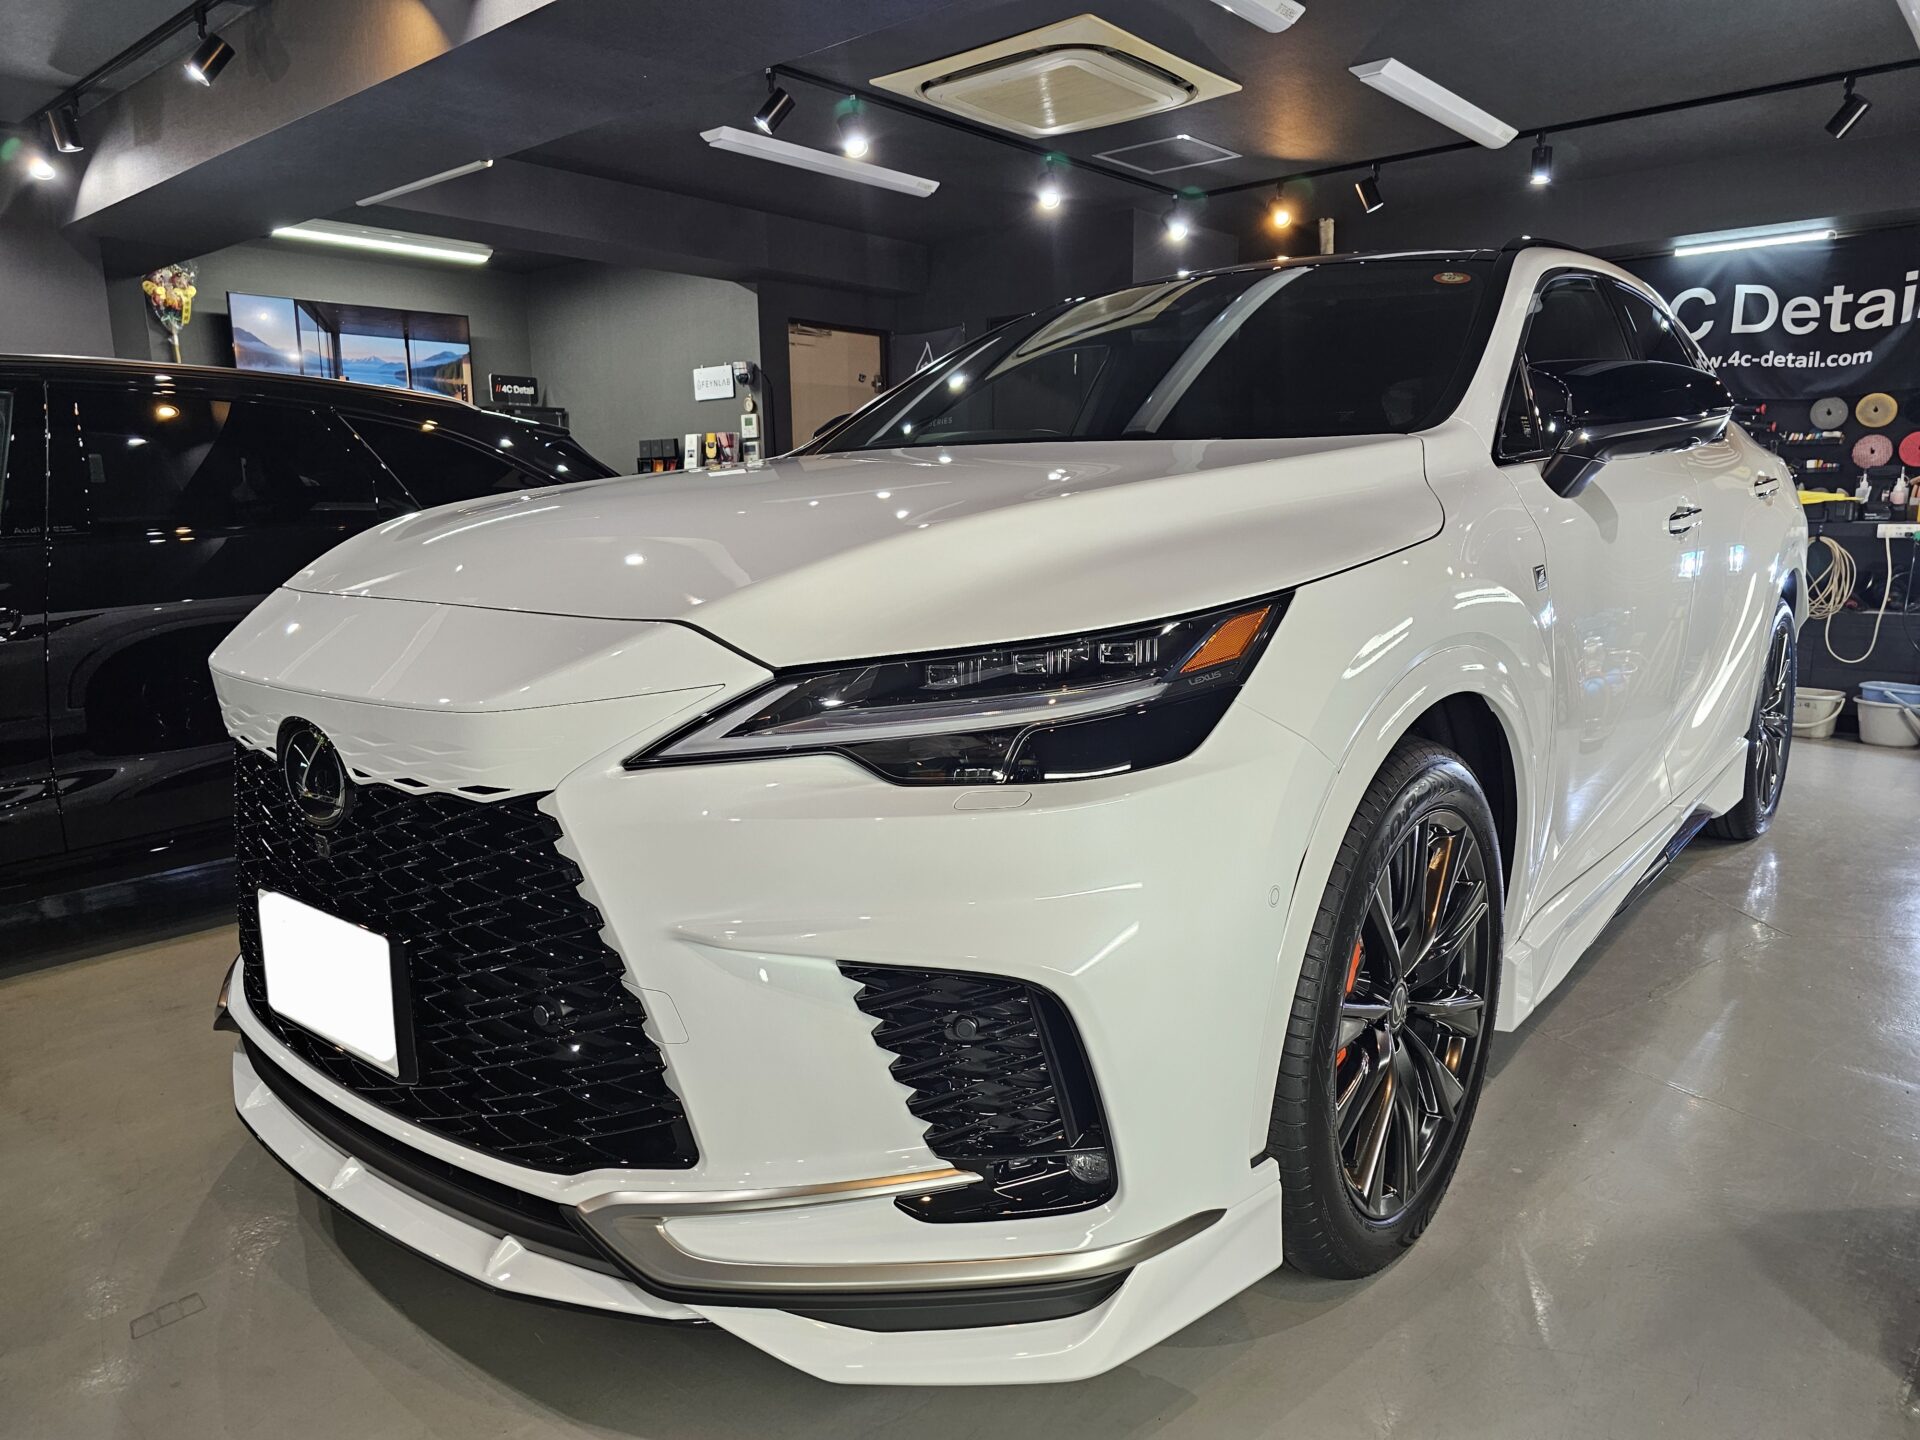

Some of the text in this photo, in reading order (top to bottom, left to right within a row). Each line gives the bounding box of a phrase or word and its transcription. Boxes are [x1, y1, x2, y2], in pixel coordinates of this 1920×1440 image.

[1669, 270, 1920, 341] C Detai
[14, 525, 41, 534] Audi
[1188, 671, 1222, 685] LEXUS
